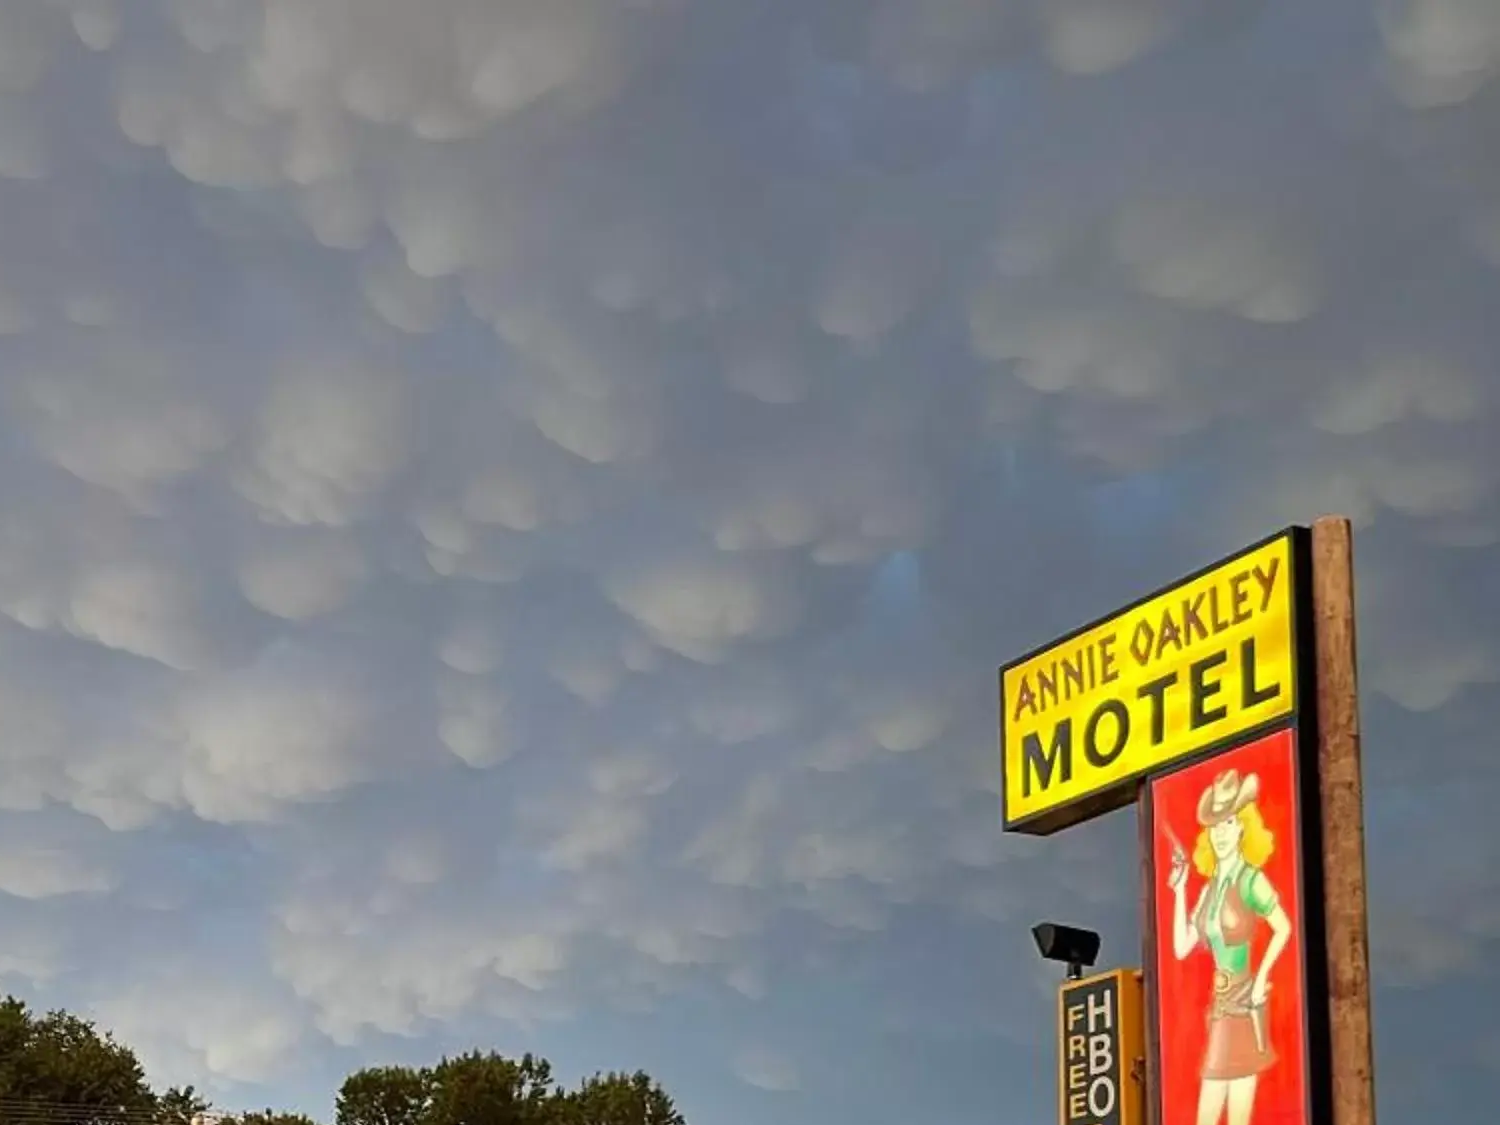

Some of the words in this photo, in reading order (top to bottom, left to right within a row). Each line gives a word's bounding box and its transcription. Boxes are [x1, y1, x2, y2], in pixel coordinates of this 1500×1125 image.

[1013, 633, 1119, 722] ANNIE
[1128, 557, 1280, 666] OAKLEY
[1021, 635, 1282, 798] MOTEL
[1067, 1004, 1087, 1119] FREE
[1087, 989, 1115, 1117] HBO
